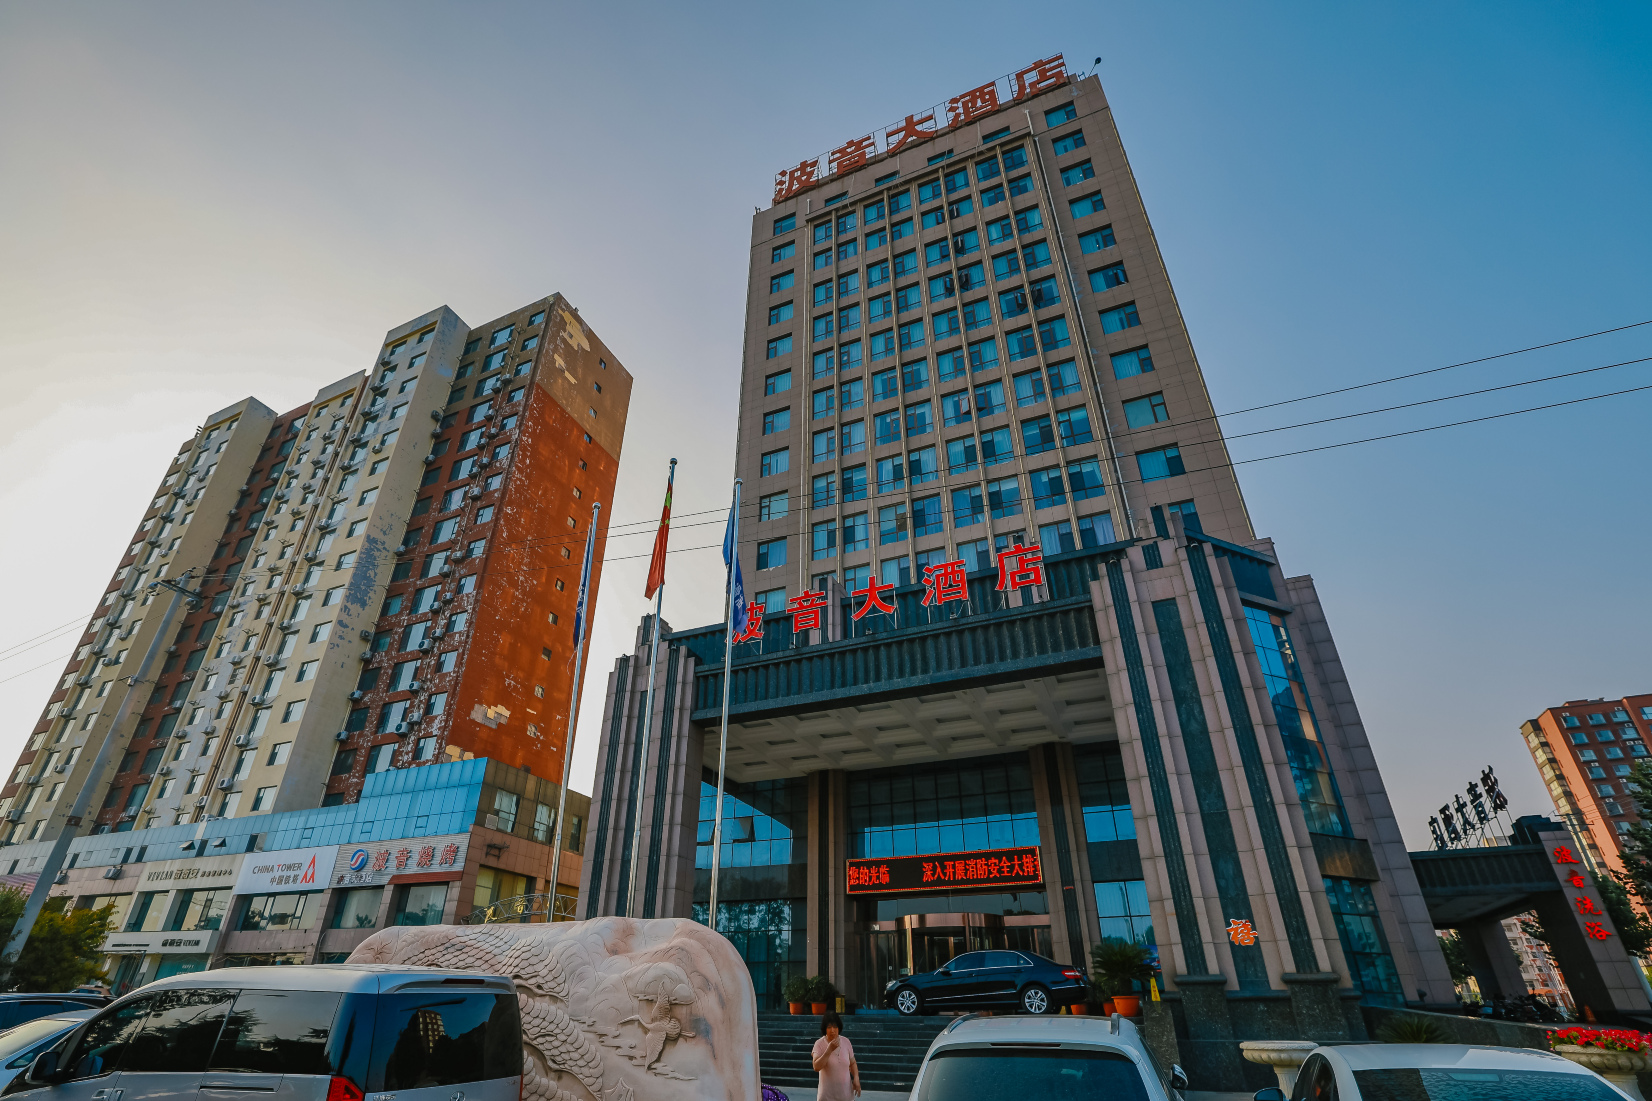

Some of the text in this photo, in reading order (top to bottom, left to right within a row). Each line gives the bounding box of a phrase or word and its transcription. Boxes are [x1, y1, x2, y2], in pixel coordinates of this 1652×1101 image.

[773, 53, 1067, 201] 波音大酒店
[252, 862, 303, 874] CHINA TOWER
[372, 843, 459, 871] 波音烧烤
[269, 873, 300, 886] 中国铁塔
[1553, 845, 1612, 940] 波音洗浴
